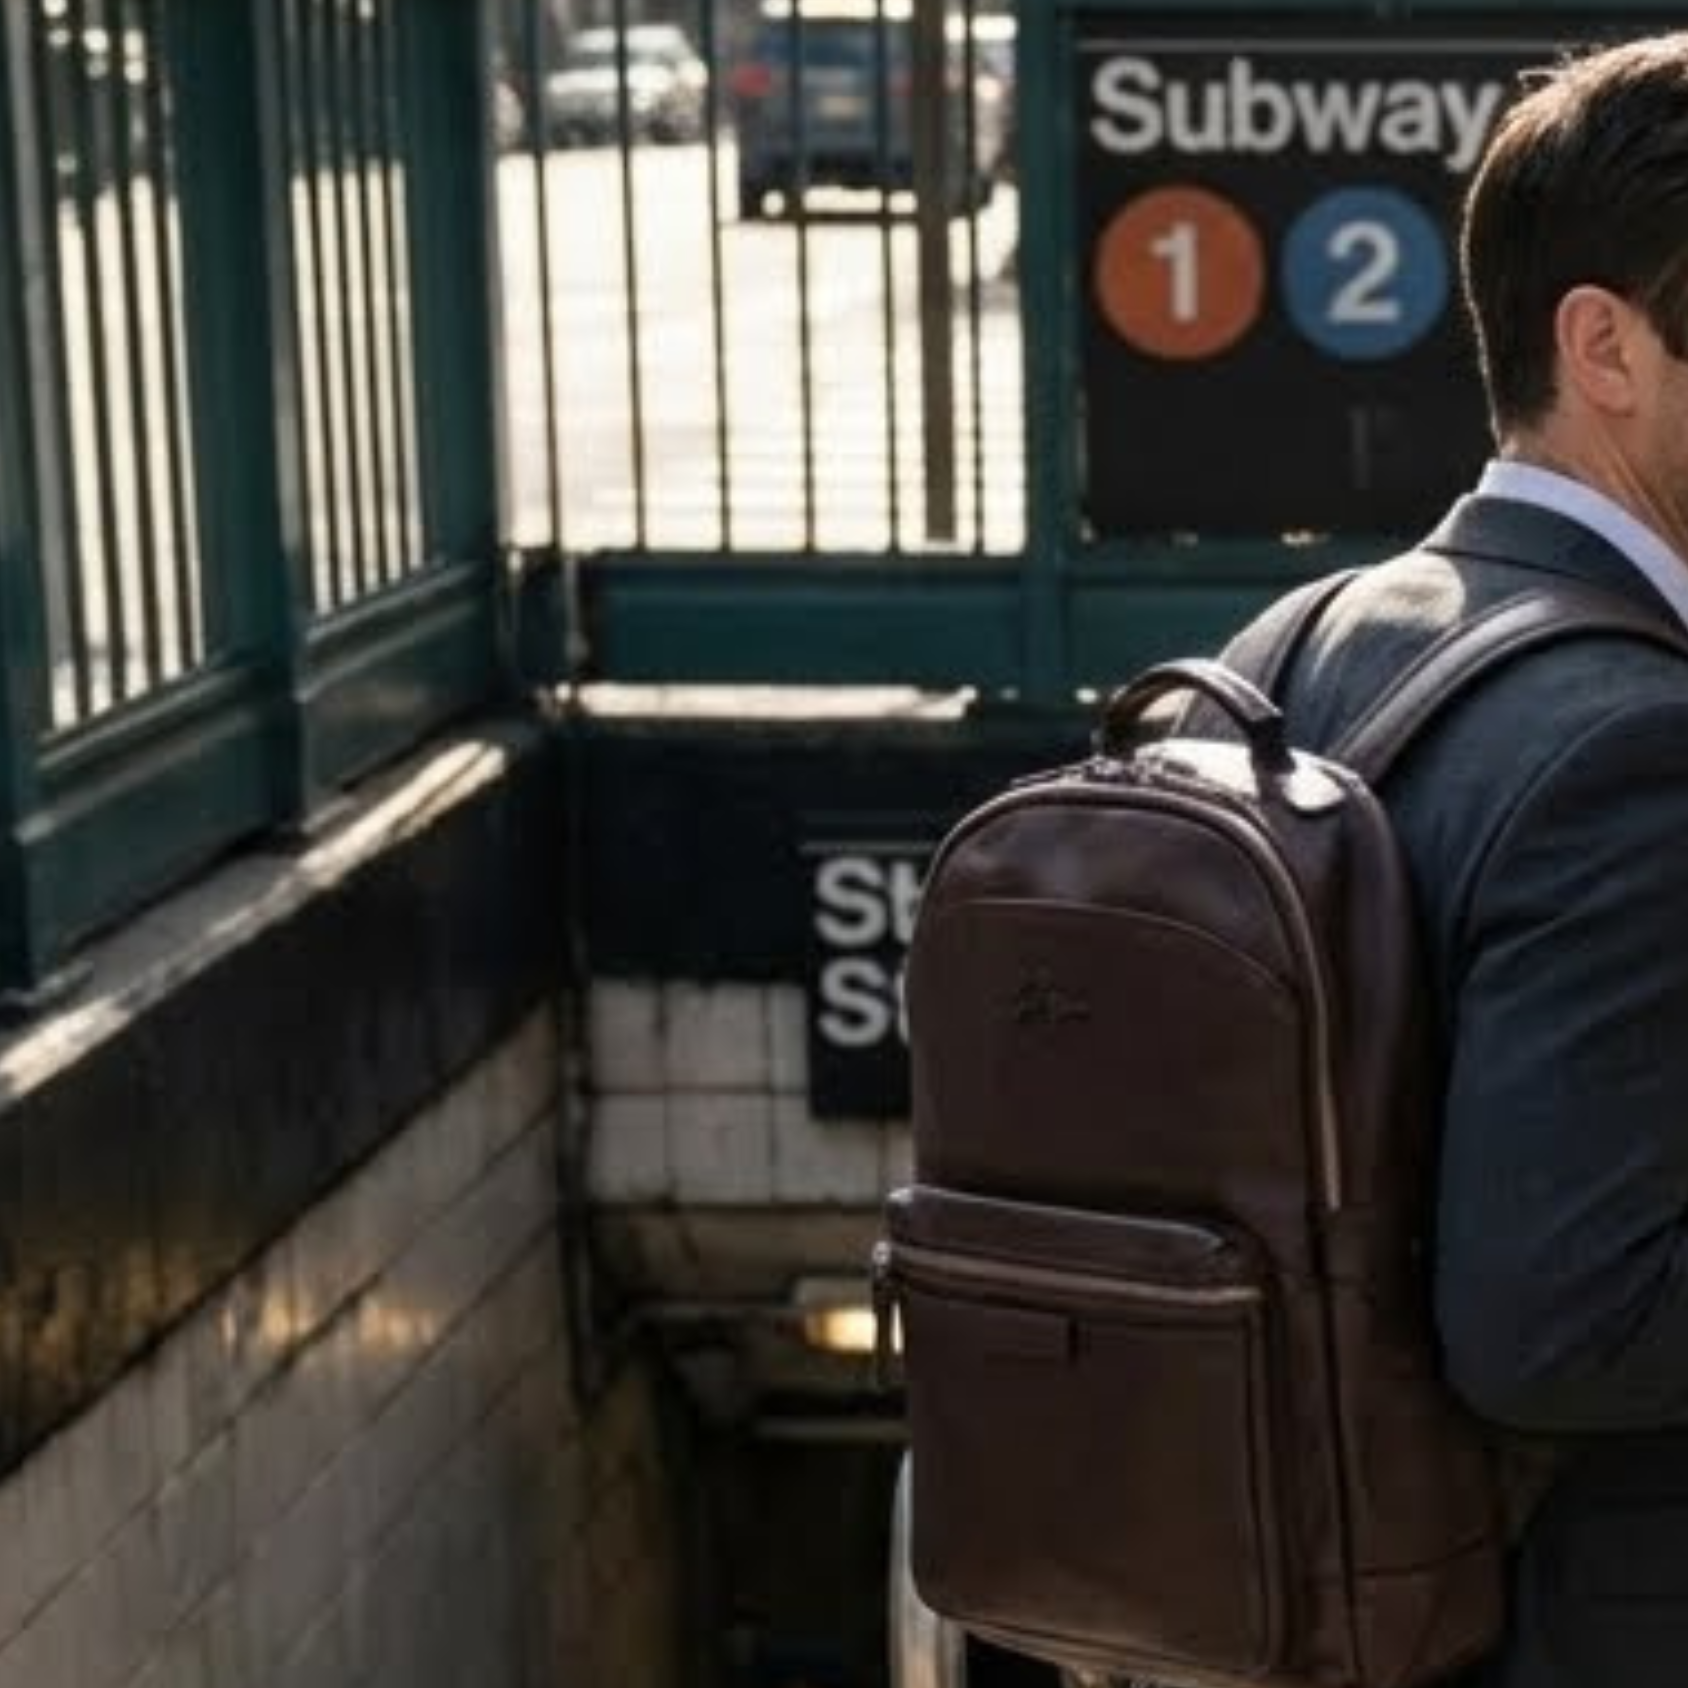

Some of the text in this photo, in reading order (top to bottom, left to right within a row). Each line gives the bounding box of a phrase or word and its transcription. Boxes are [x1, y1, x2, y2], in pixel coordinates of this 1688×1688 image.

[1091, 57, 1501, 171] Subway
[1151, 221, 1400, 323] 1 2
